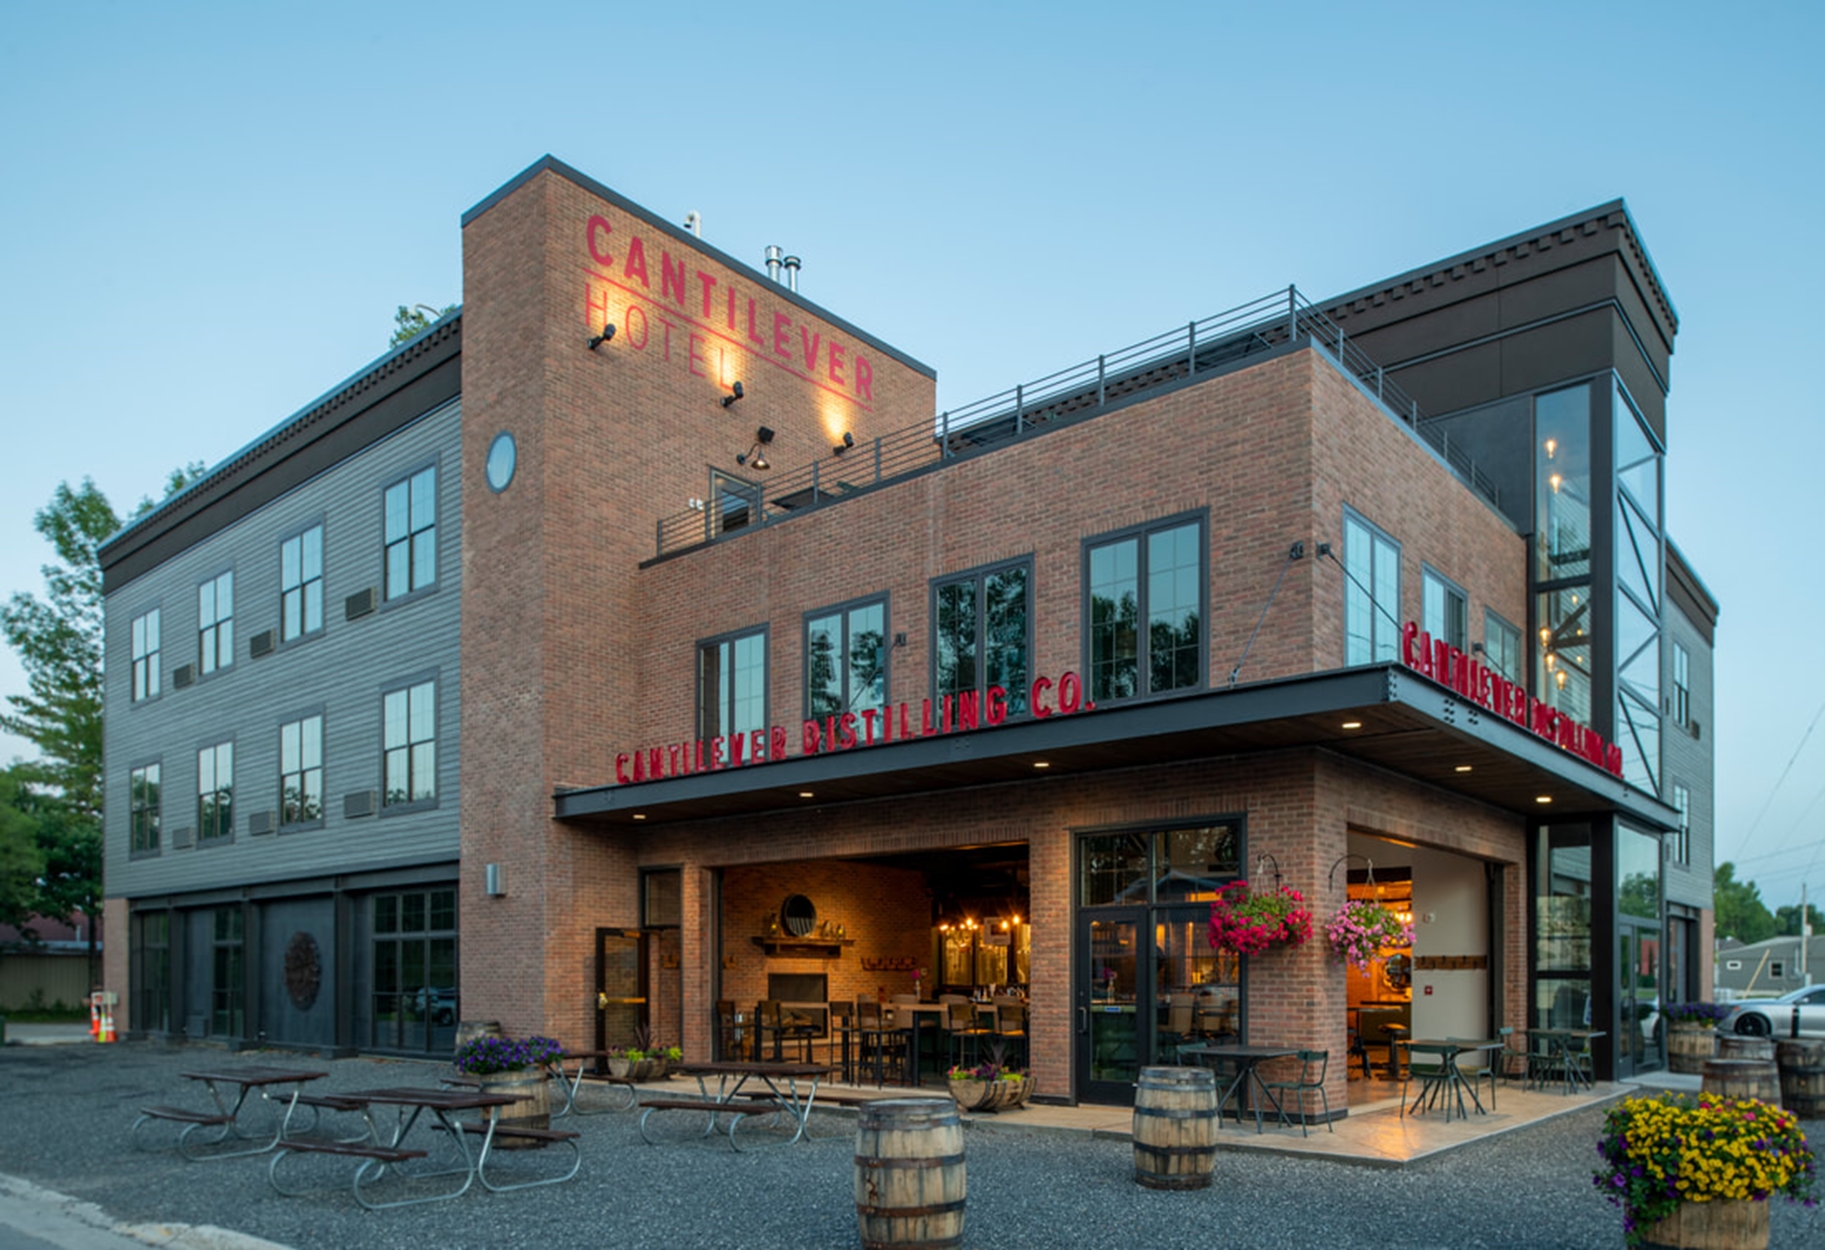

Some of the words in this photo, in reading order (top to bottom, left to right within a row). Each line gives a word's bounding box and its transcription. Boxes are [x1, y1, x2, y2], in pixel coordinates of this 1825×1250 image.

[585, 282, 734, 390] HOTEL
[586, 214, 873, 401] CANTILEVER
[615, 725, 787, 785] CANTILEVER
[803, 685, 1008, 756] DISTILLING
[1031, 671, 1096, 719] CO.
[1402, 621, 1527, 727] CANTILEVER
